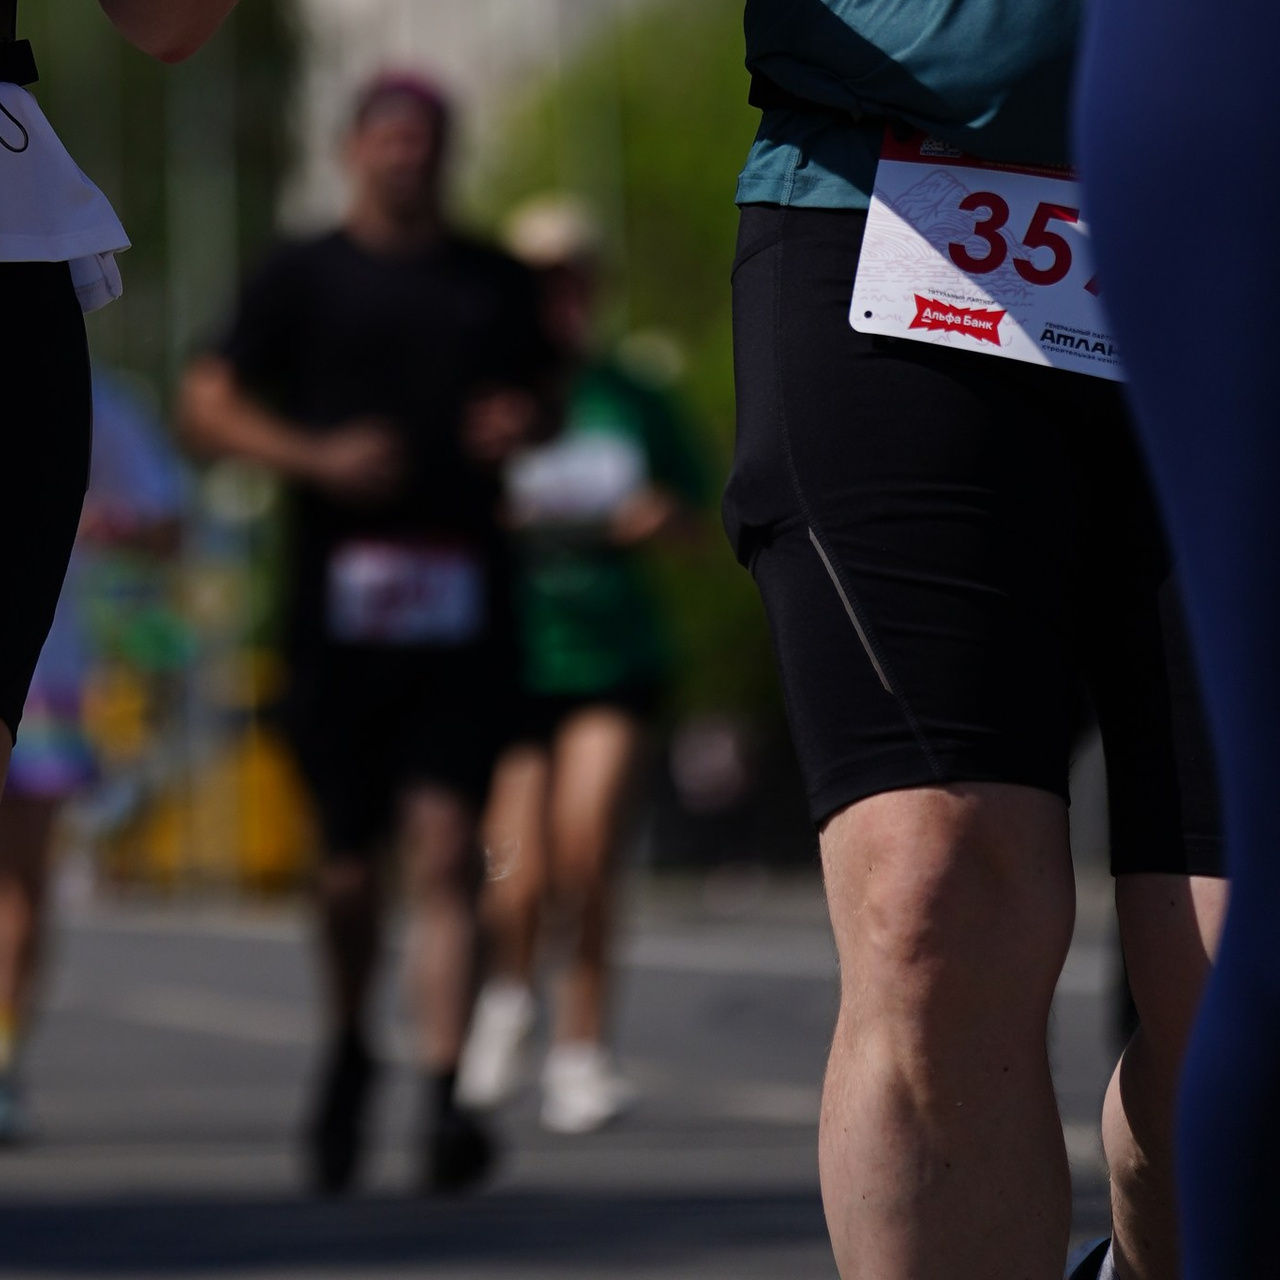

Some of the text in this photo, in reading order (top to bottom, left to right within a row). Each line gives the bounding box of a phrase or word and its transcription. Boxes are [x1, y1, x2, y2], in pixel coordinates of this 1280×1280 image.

[948, 191, 1100, 298] 35
[921, 307, 994, 331] Альфа Банк
